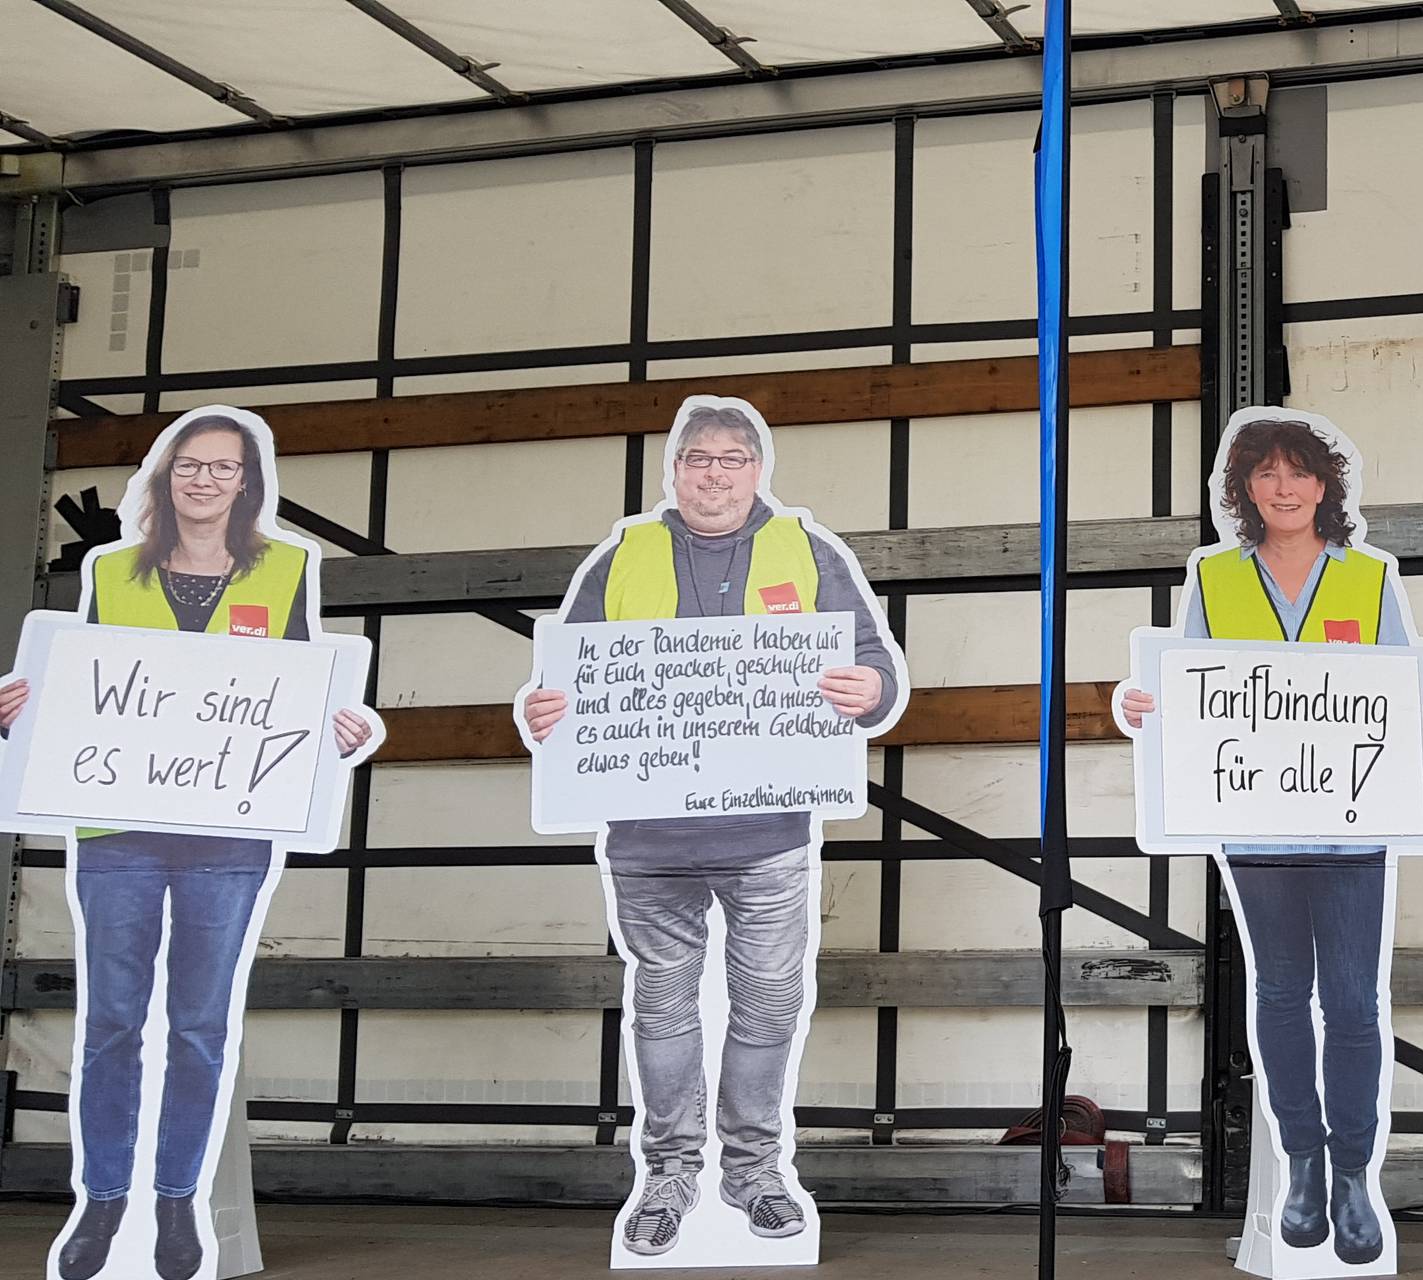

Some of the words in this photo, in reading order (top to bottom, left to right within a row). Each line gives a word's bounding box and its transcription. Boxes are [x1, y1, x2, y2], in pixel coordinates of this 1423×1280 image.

[767, 600, 799, 611] ver.di
[231, 624, 267, 637] ver.di
[578, 636, 599, 661] In
[609, 634, 645, 658] der
[650, 626, 743, 654] Pandemie
[754, 623, 811, 650] haben
[816, 625, 843, 650] wir
[574, 663, 598, 694] für
[604, 661, 645, 684] Euch
[651, 656, 732, 691] geackert,
[736, 651, 824, 686] geschuftet
[94, 659, 177, 718] Wir
[195, 677, 281, 730] sind
[576, 692, 610, 715] und
[620, 687, 667, 712] alles
[673, 684, 750, 719] gegeben,
[753, 685, 777, 709] da
[781, 690, 824, 709] muss
[1186, 664, 1388, 742] Tarifbindung
[576, 725, 598, 744] es
[603, 717, 651, 740] auch
[657, 715, 676, 740] in
[683, 719, 760, 740] unserem
[769, 711, 855, 739] Geldbeutel
[73, 745, 121, 786] es
[577, 752, 631, 774] etwas
[637, 740, 701, 781] geben!
[1213, 738, 1264, 803] für
[685, 792, 718, 811] Eure
